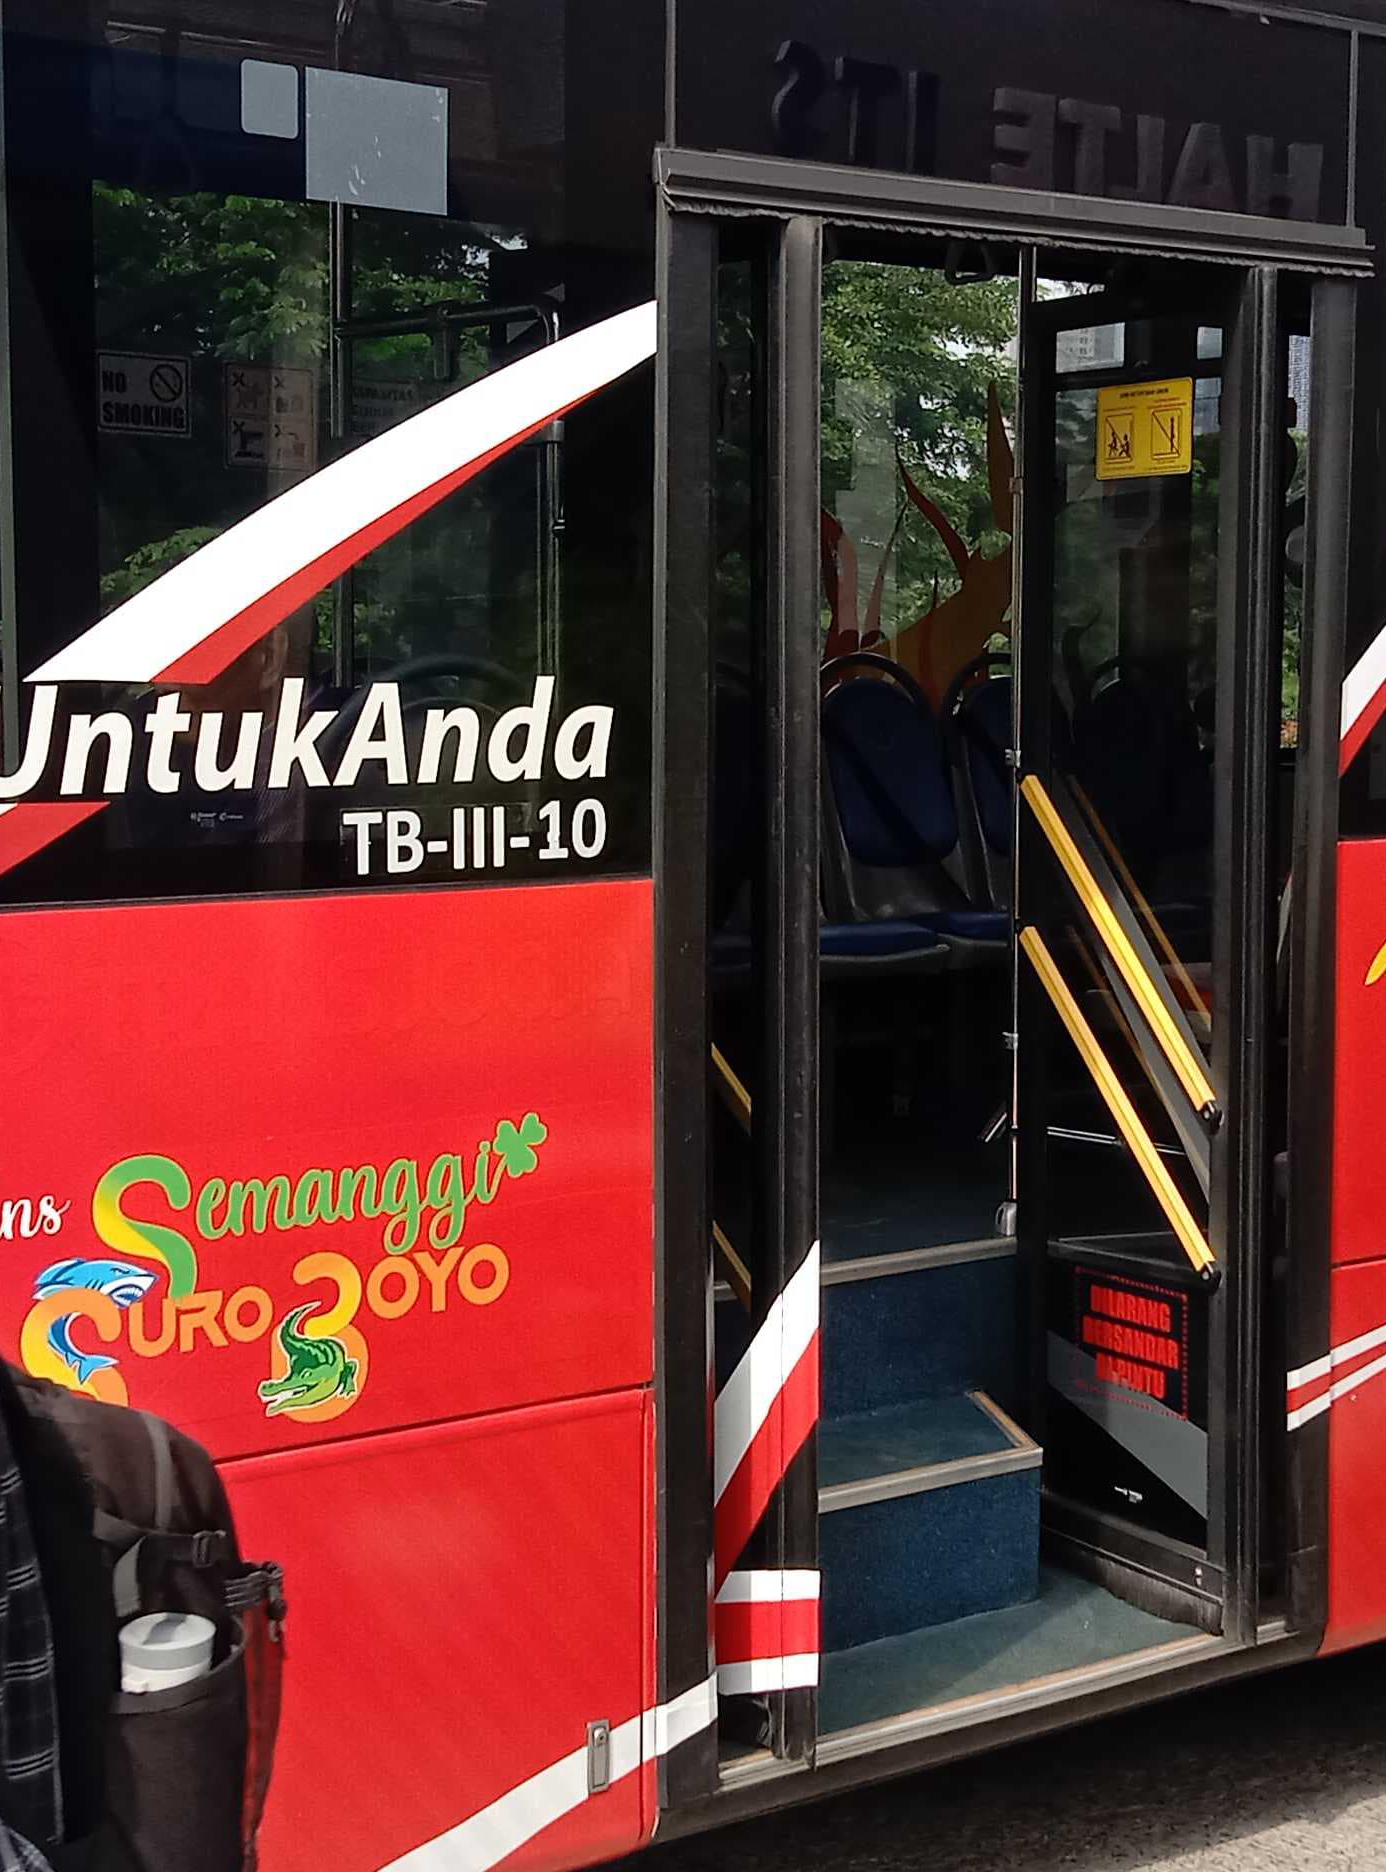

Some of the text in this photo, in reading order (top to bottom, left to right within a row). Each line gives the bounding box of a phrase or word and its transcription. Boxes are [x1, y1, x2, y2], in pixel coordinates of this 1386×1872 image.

[102, 371, 126, 393] NO
[102, 401, 186, 429] SMOKING
[342, 799, 608, 876] TB-III-10
[92, 1139, 506, 1298] Semanggi
[1090, 1284, 1172, 1334] DILARANG
